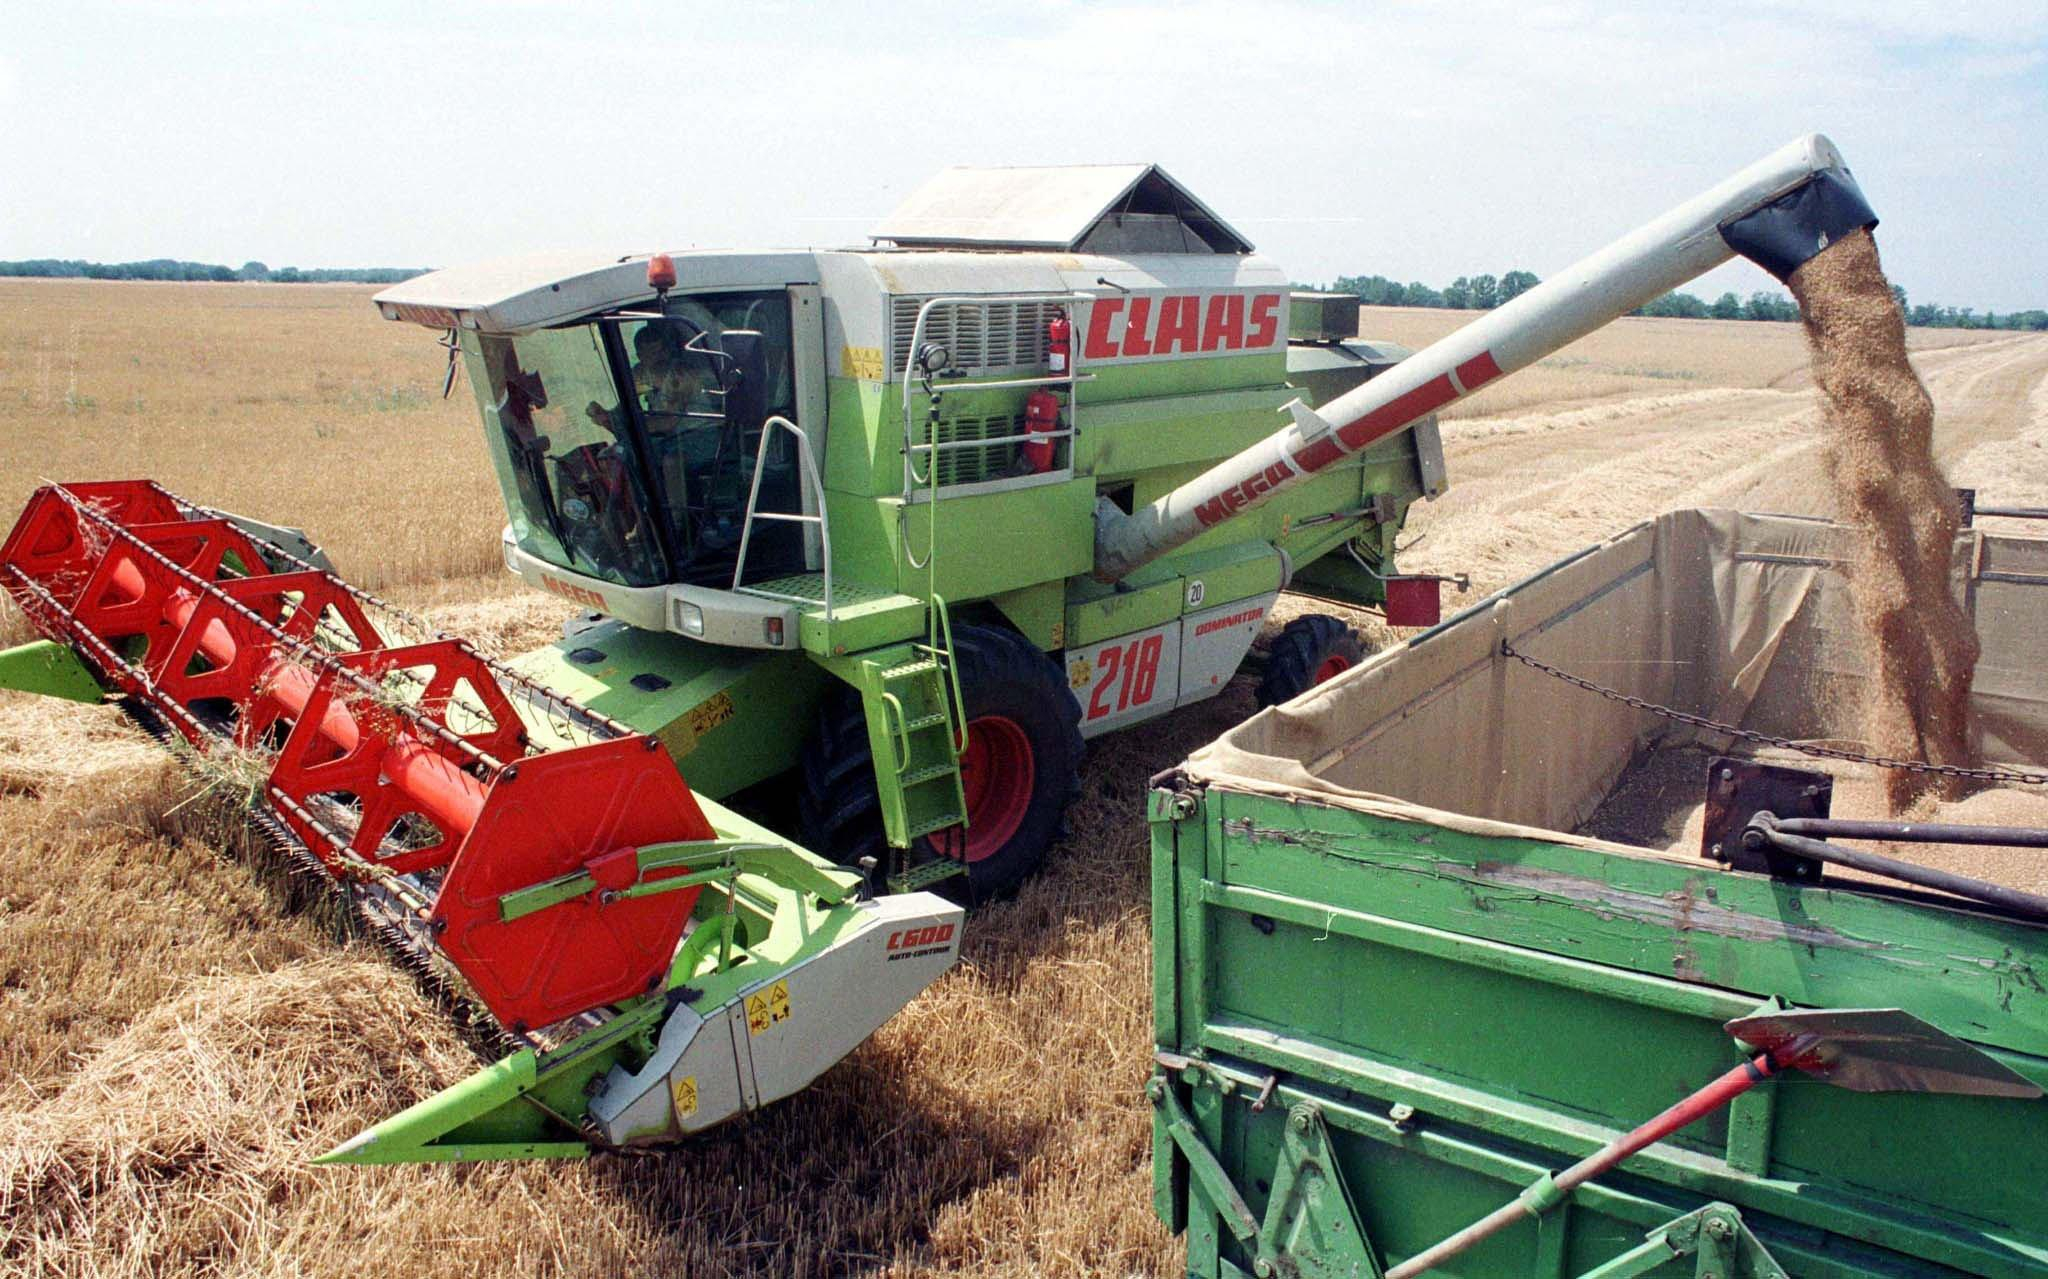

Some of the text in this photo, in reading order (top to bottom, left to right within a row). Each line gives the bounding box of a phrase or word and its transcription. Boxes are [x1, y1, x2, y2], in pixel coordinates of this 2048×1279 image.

[1084, 294, 1280, 359] CLAAS
[1193, 460, 1296, 527] MEGA
[1191, 584, 1202, 603] 20
[1195, 607, 1264, 636] DOMINATOR
[1087, 634, 1163, 720] 218
[887, 923, 955, 952] C600
